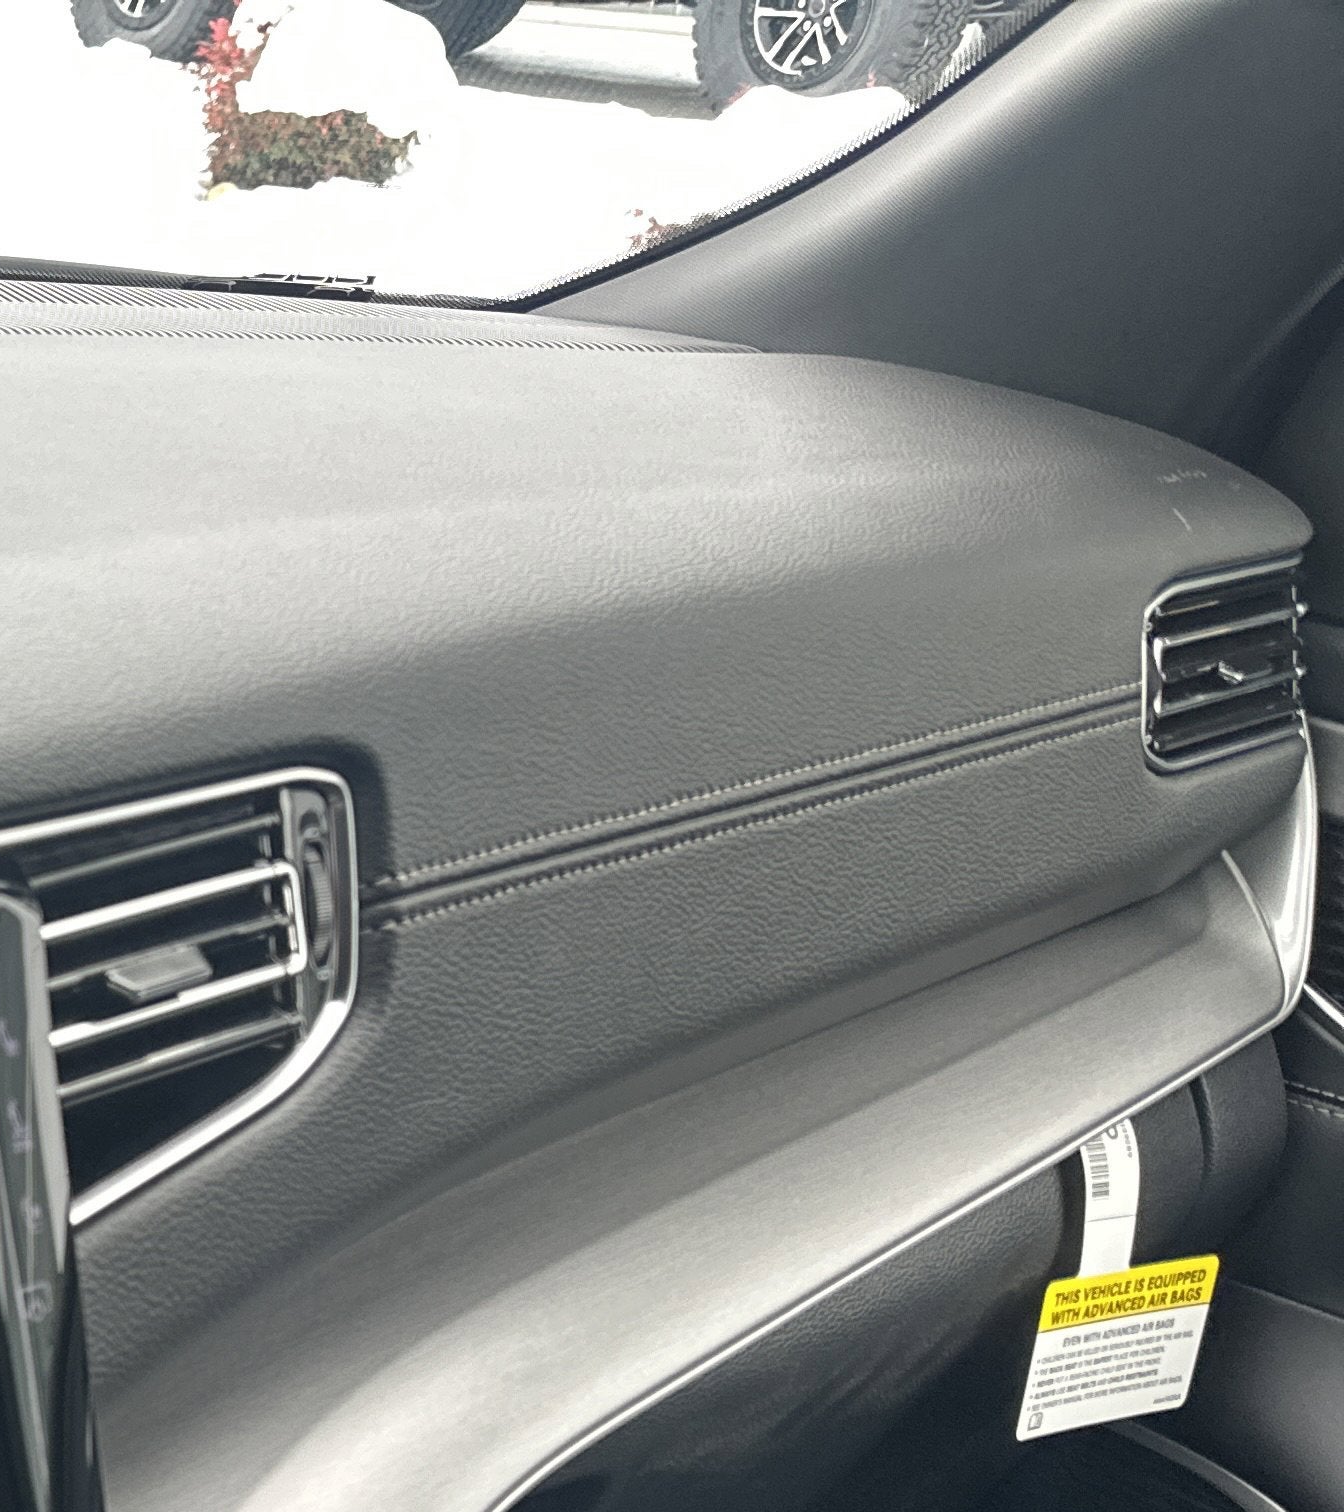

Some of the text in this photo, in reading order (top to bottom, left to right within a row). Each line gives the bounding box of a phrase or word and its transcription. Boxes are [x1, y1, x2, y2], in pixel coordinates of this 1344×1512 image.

[1051, 1287, 1203, 1326] WITH ADVANCED AIR BAGS
[1055, 1269, 1207, 1307] THIS VEHICLE IS EQUIPPED
